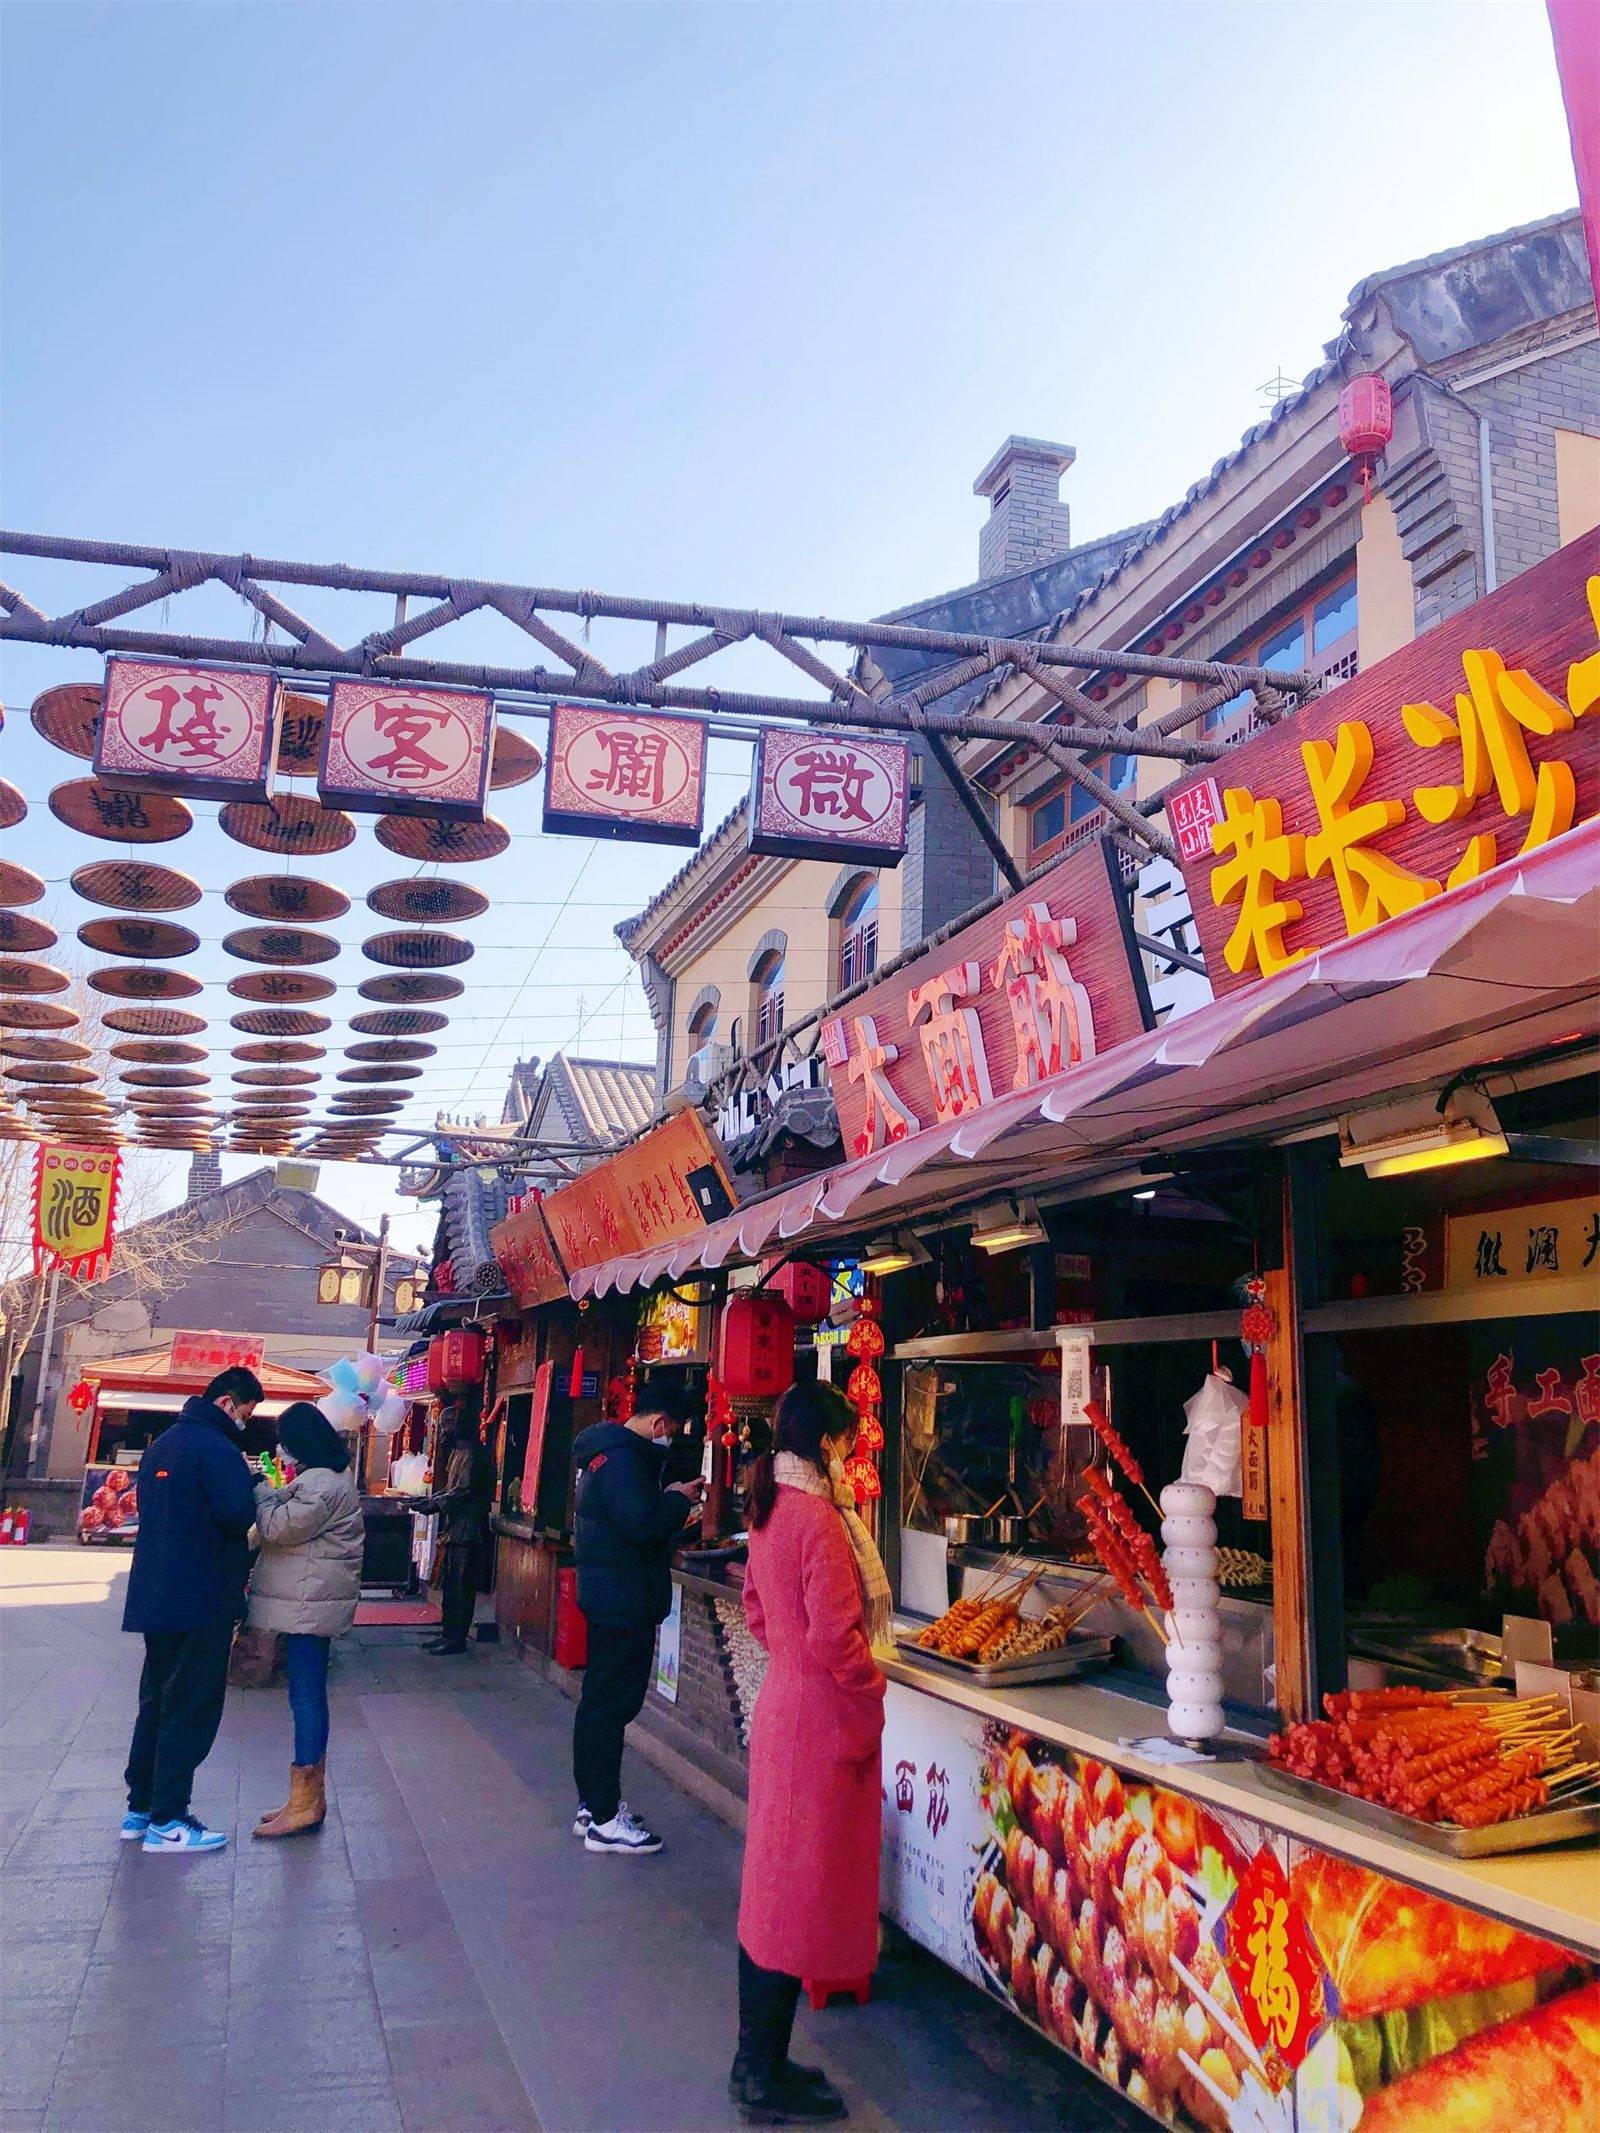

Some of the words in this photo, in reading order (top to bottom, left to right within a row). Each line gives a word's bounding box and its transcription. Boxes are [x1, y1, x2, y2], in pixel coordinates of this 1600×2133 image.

[367, 702, 453, 780] 客
[1210, 575, 1600, 979] 老长沙
[788, 750, 874, 824] 微
[846, 901, 1098, 1160] 大面筋
[47, 1177, 103, 1240] 酒
[881, 1759, 950, 1839] 面筋
[1246, 1887, 1300, 2049] 福
